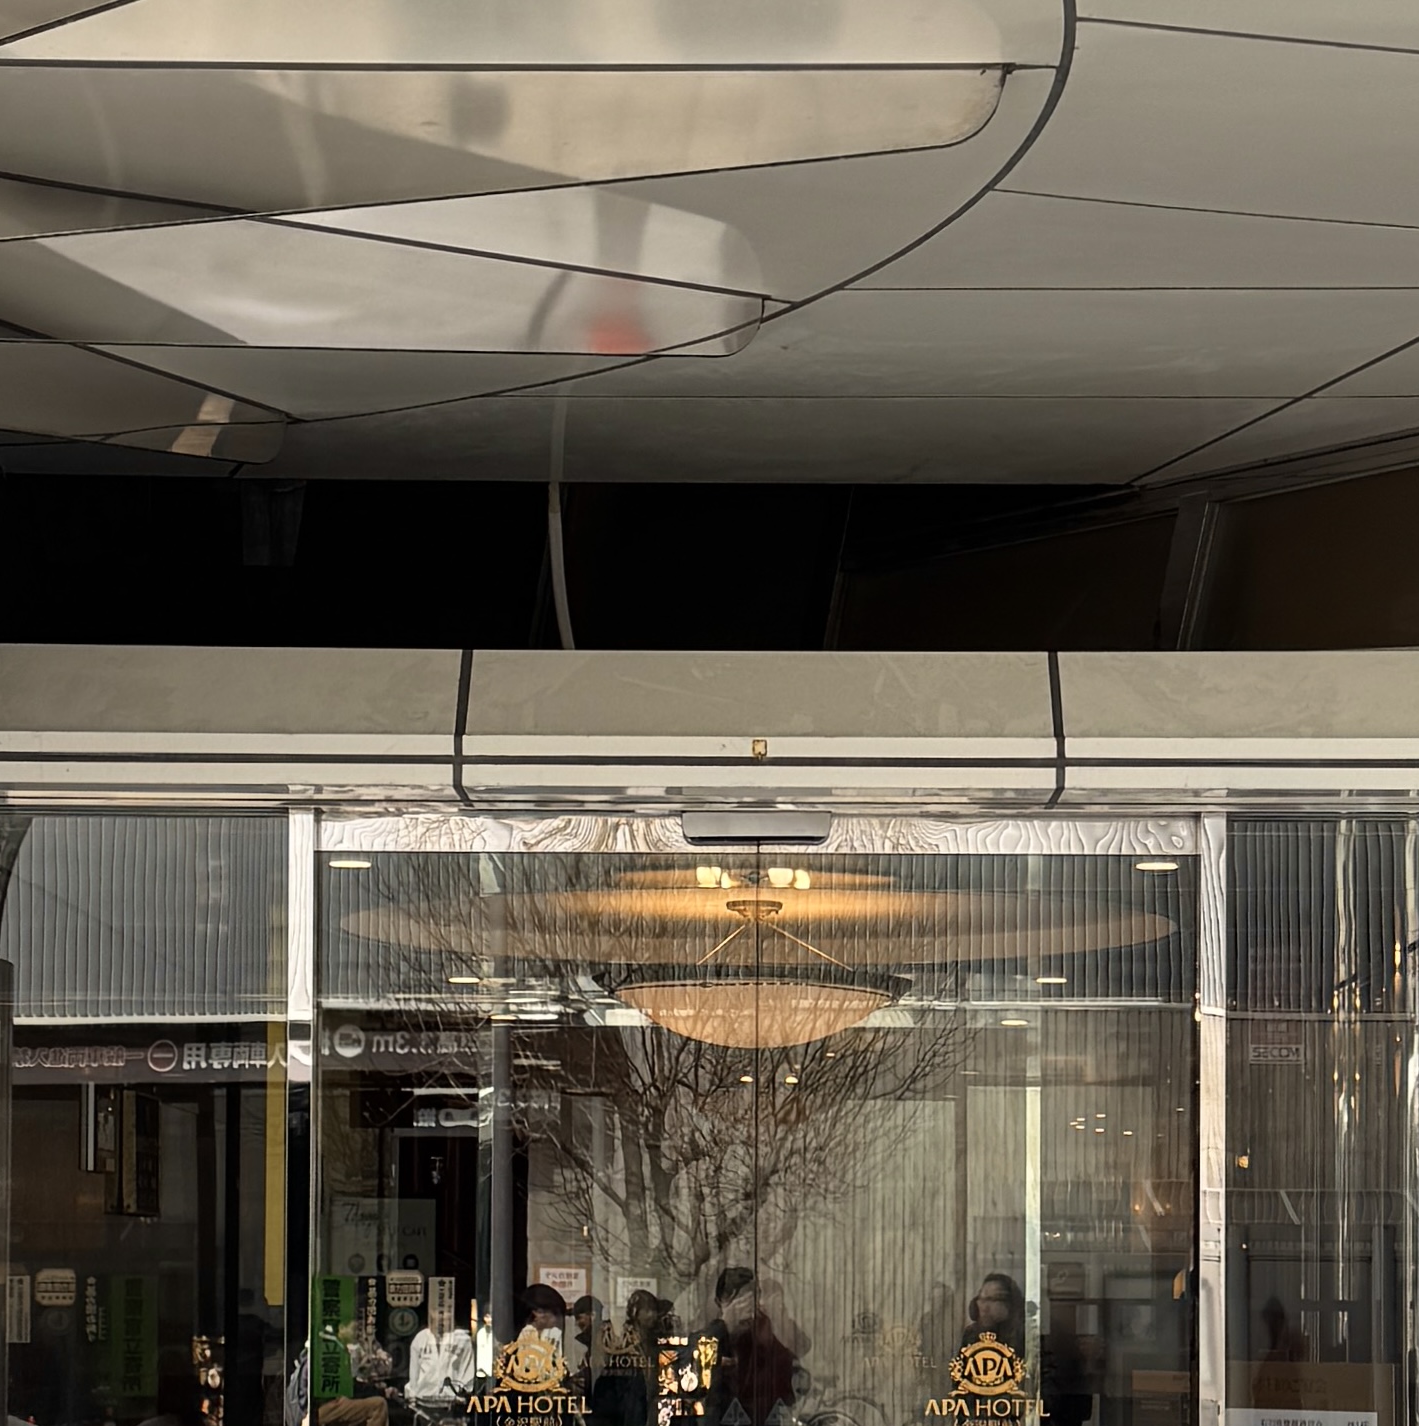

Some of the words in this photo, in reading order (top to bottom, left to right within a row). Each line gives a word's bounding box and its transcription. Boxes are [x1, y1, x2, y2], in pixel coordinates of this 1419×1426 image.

[466, 1396, 511, 1414] APA
[518, 1396, 592, 1414] HOTEL
[925, 1399, 970, 1416] APA
[976, 1399, 1050, 1417] HOTEL
